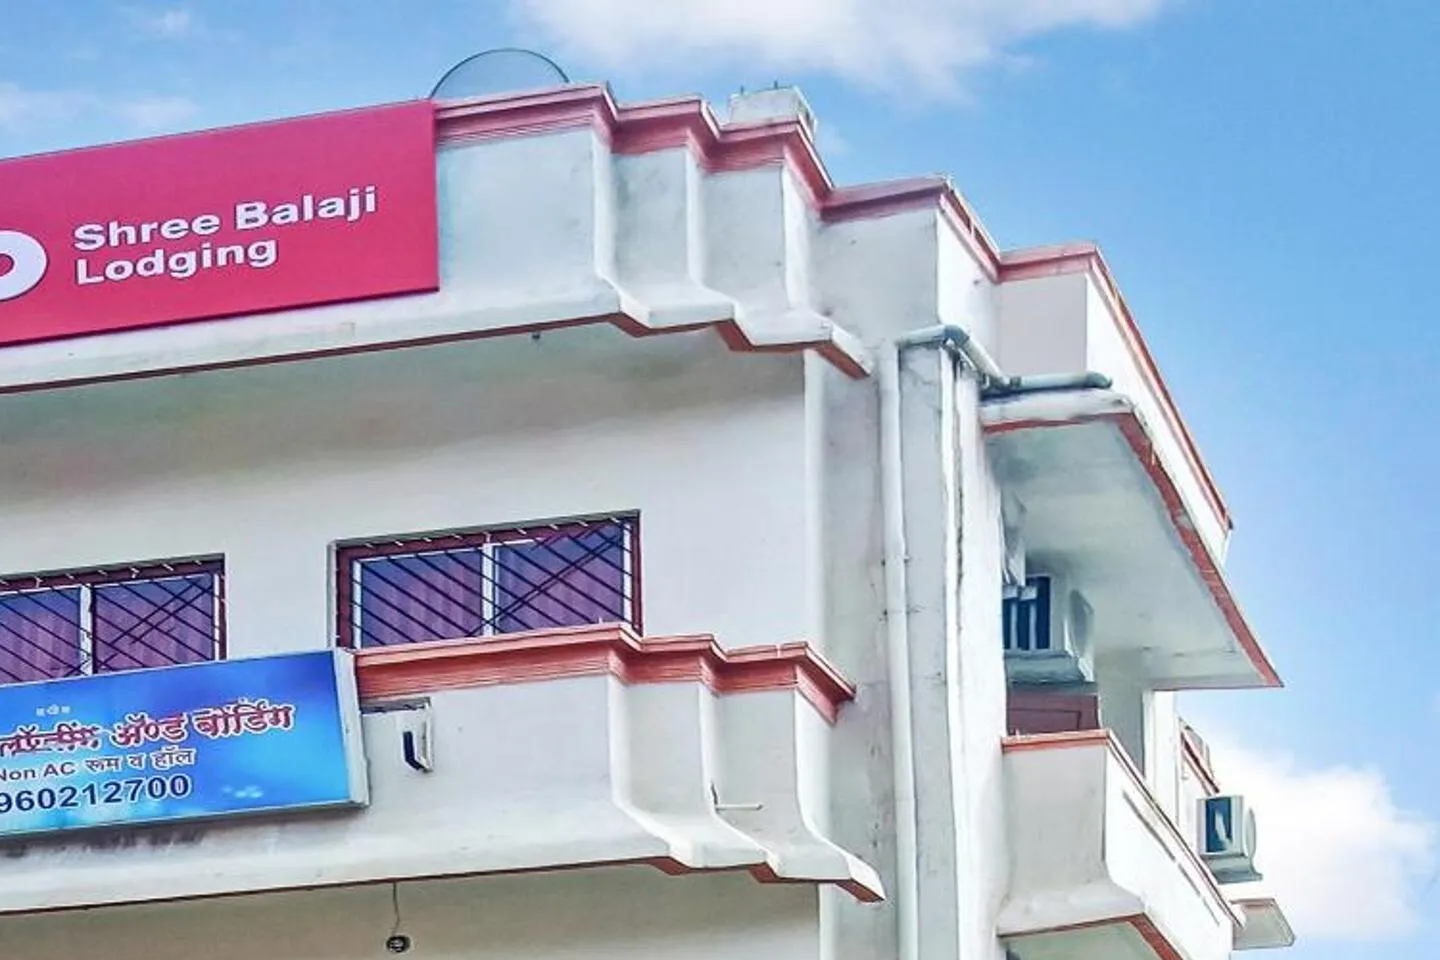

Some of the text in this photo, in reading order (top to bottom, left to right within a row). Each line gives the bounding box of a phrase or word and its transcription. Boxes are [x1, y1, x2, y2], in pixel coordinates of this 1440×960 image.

[73, 184, 378, 252] Shree Balaji
[75, 239, 279, 286] Lodging
[43, 761, 76, 778] AC
